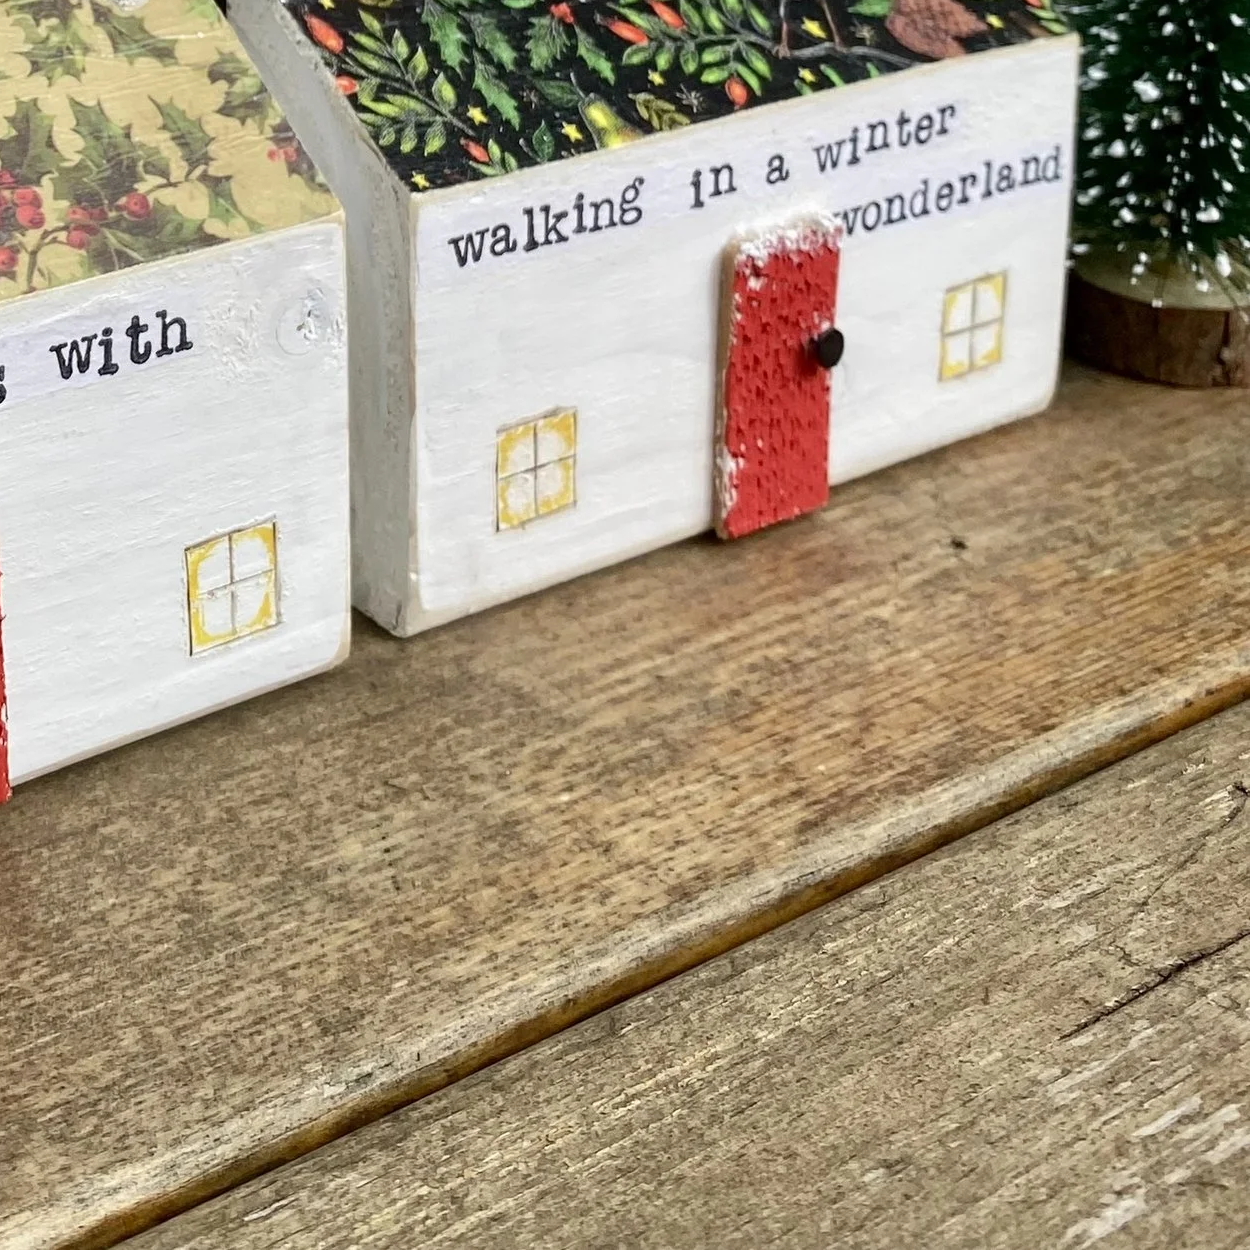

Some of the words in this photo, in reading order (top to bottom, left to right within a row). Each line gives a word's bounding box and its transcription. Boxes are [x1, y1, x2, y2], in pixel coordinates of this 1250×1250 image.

[447, 176, 646, 268] walking
[689, 159, 737, 209] in
[766, 154, 790, 185] a
[814, 105, 956, 173] winter
[833, 145, 1063, 236] wonderland
[48, 309, 194, 381] with
